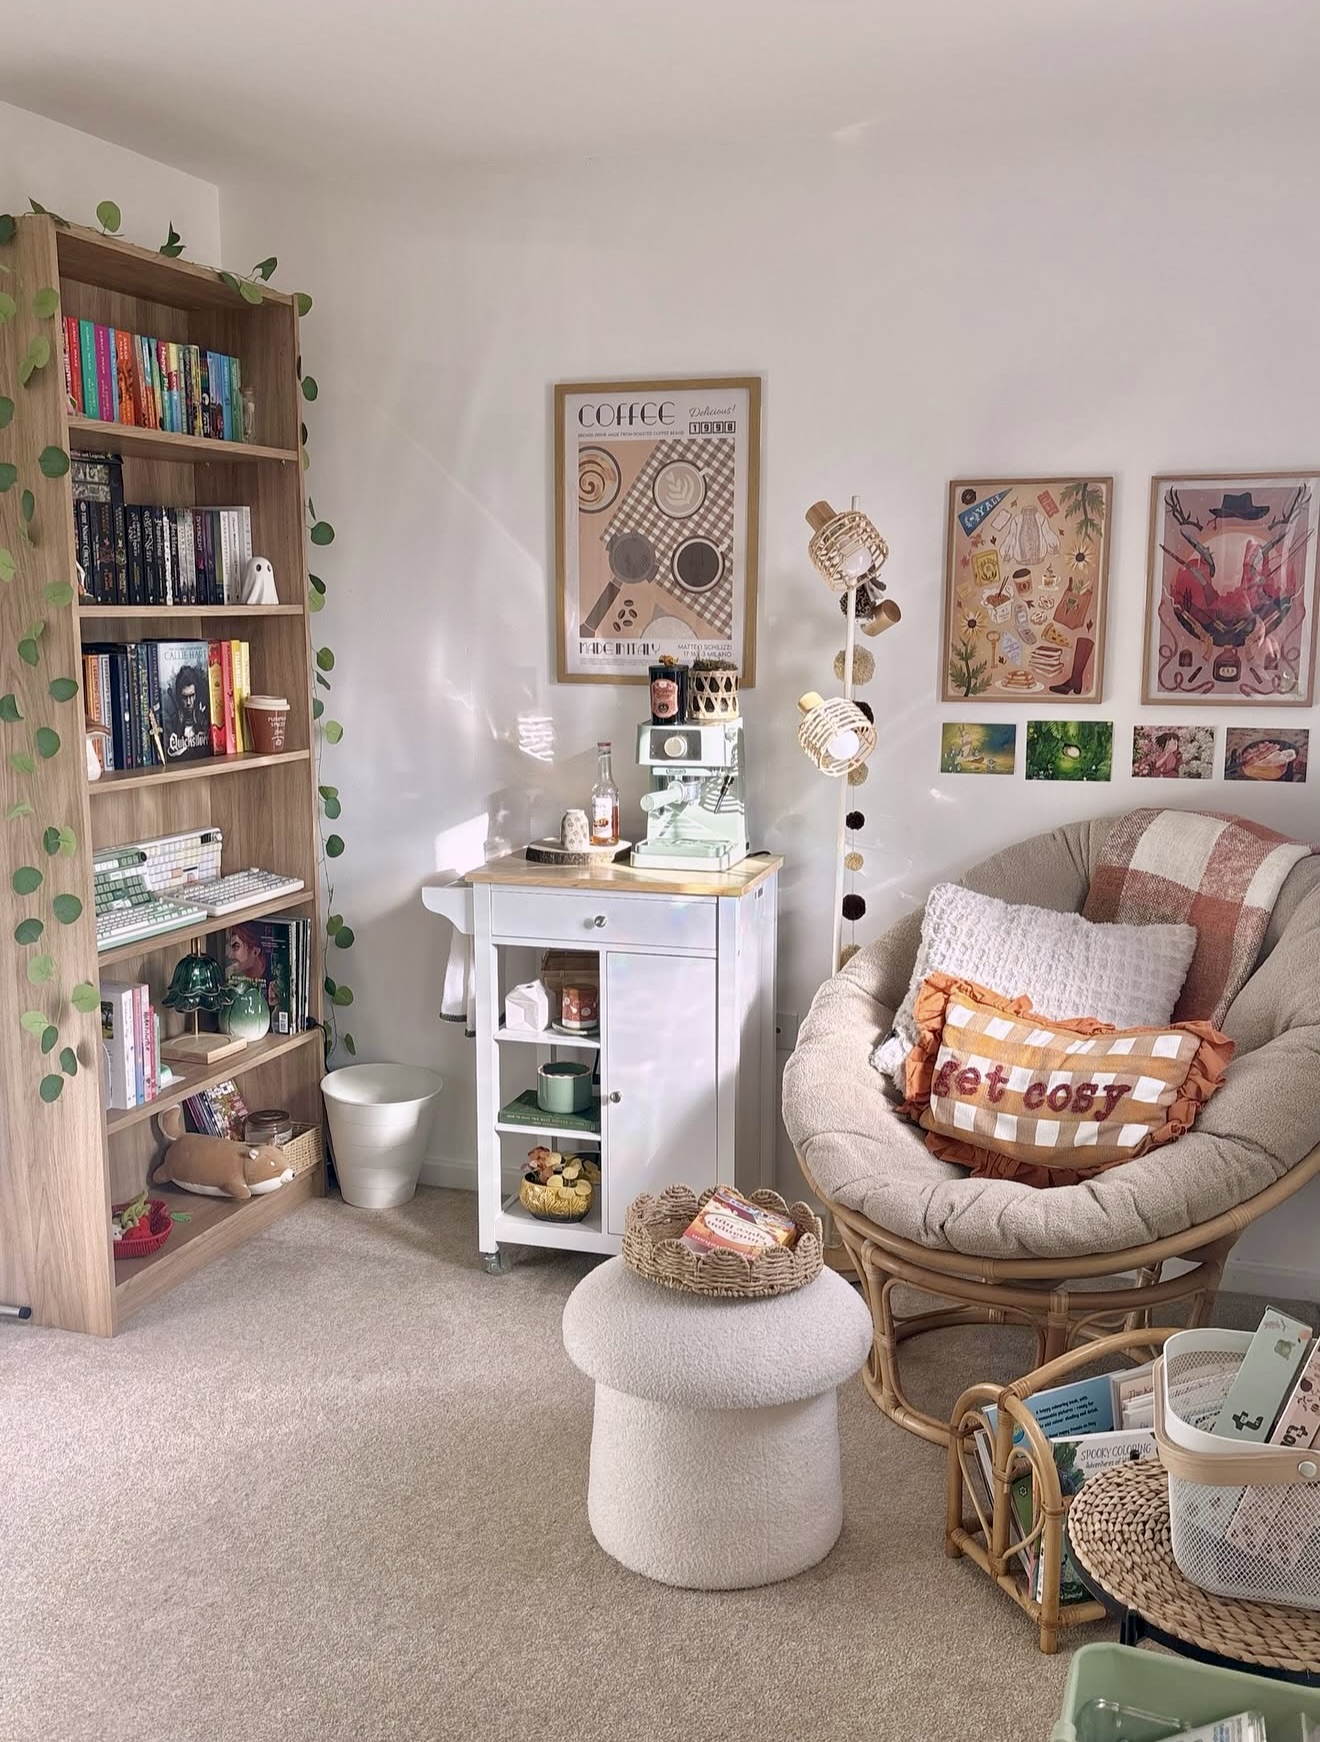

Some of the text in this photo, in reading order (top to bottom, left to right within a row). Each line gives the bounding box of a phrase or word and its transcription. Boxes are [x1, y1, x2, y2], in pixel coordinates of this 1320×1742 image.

[160, 346, 168, 377] Happy
[578, 401, 676, 428] COFFEE
[689, 404, 736, 418] Delicious!
[690, 421, 735, 434] 1998
[81, 524, 89, 544] NIGHT
[195, 515, 203, 551] DIVERGENT
[82, 545, 90, 567] CIRCUS
[164, 650, 206, 660] CALLIE HART
[579, 642, 614, 655] MADE
[627, 643, 661, 656] ITALY
[933, 1059, 1131, 1121] get cosy
[1051, 1402, 1069, 1410] colouring
[1058, 1408, 1073, 1417] pictures
[1081, 1443, 1151, 1461] SPOOKY COLORING
[1086, 1460, 1114, 1469] Adventures
